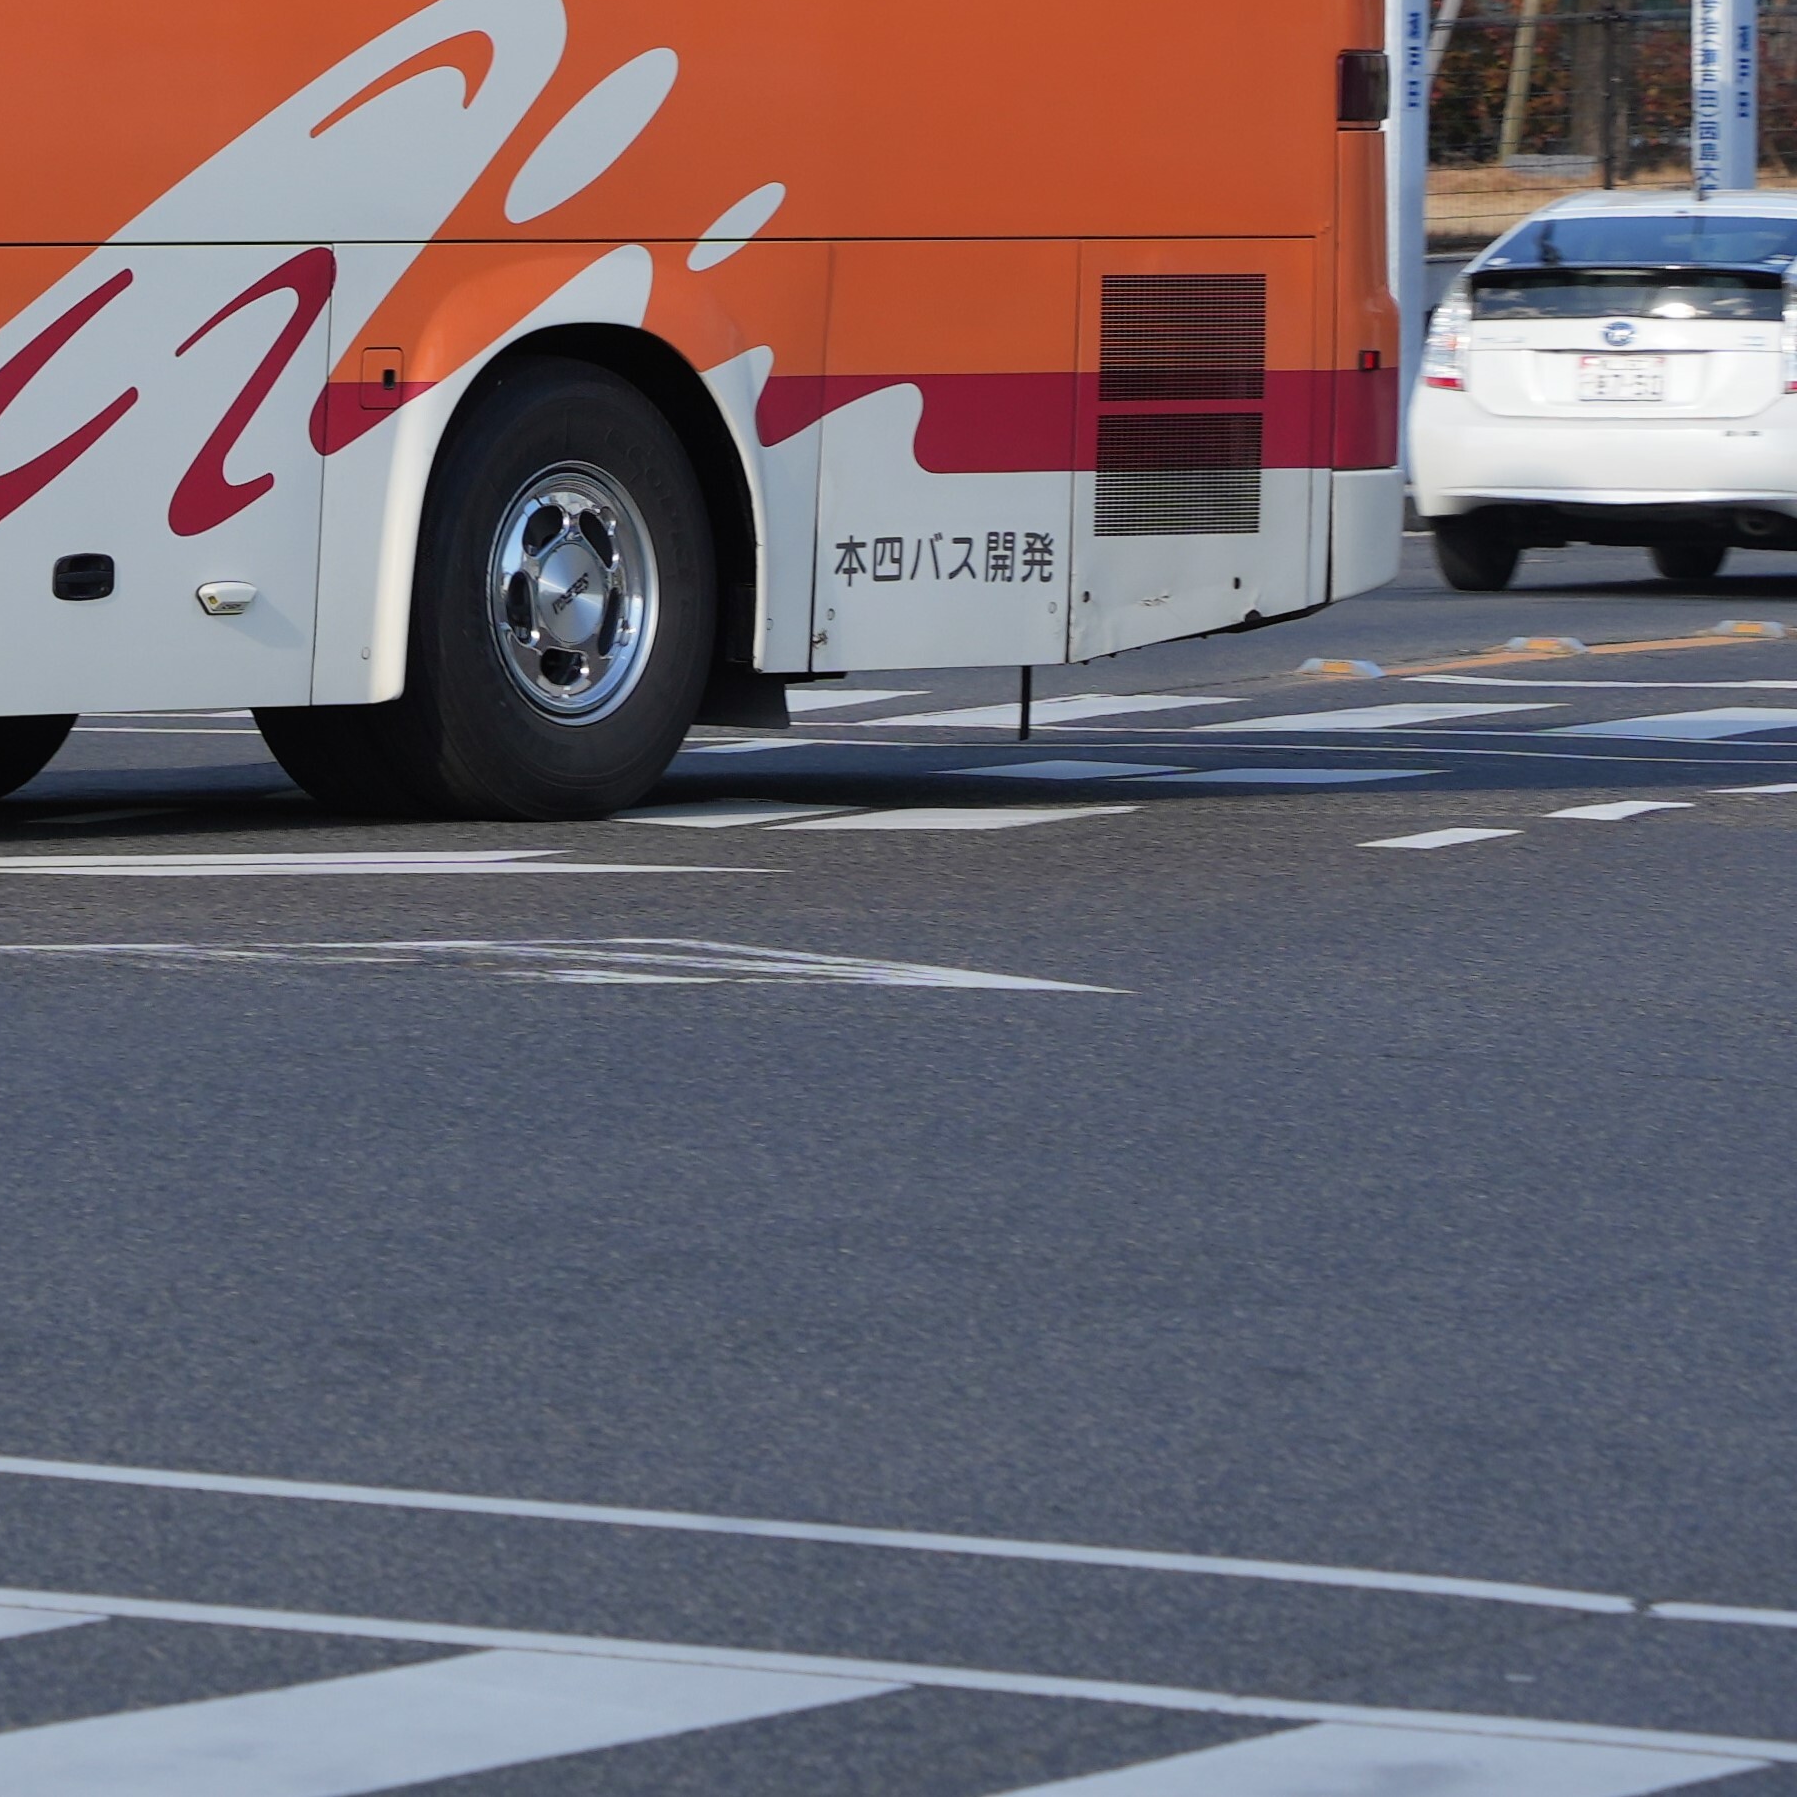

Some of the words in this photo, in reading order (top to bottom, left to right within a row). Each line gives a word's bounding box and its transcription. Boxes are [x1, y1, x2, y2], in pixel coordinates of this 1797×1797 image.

[834, 531, 1055, 587] 本四バス開発
